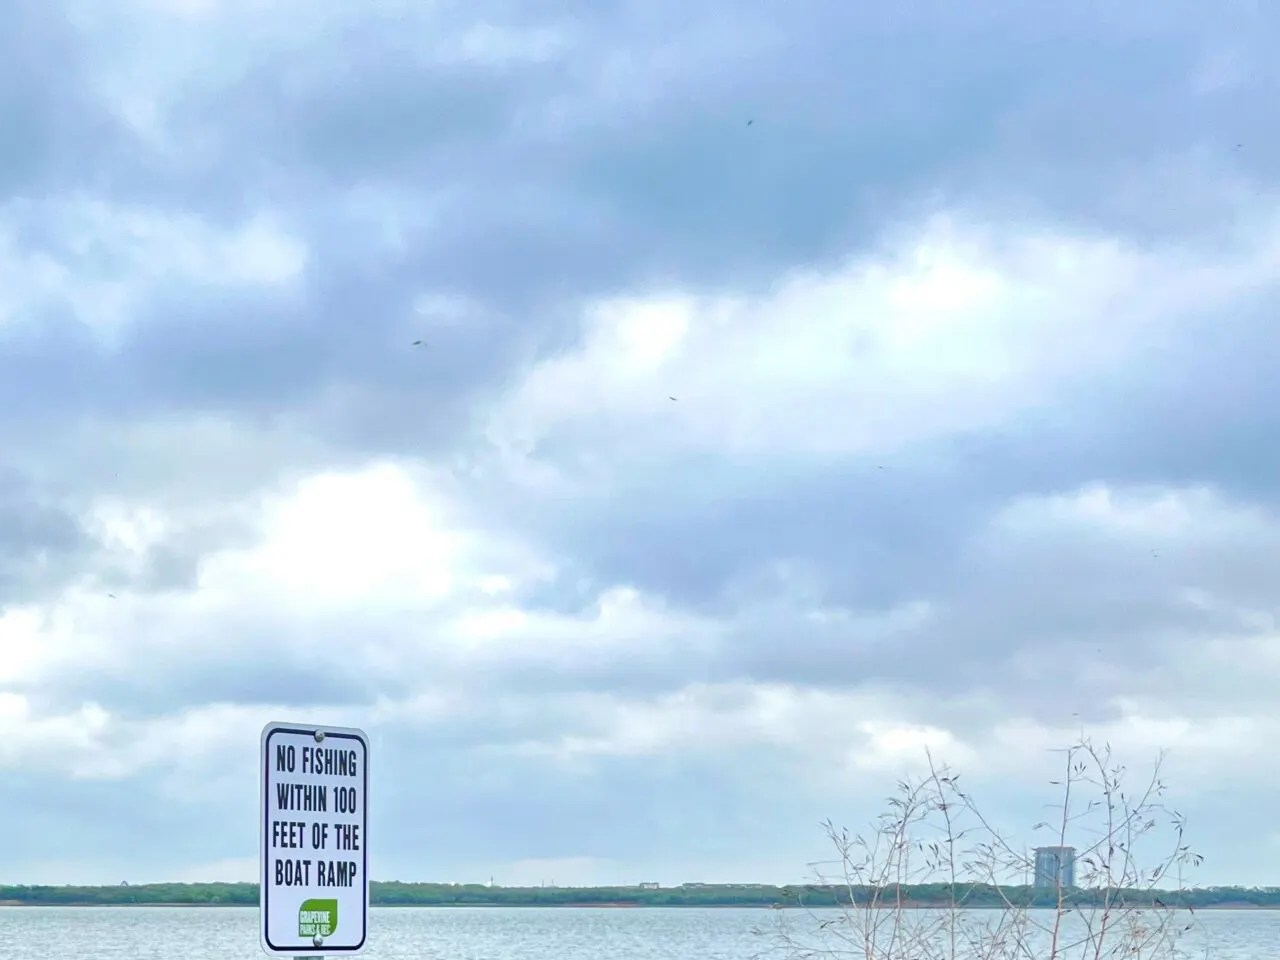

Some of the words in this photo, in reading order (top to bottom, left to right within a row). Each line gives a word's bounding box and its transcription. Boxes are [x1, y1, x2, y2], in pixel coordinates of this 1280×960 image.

[276, 745, 295, 773] NO
[302, 747, 357, 777] FISHING
[277, 783, 327, 812] WITHIN
[333, 787, 357, 814] 100
[273, 821, 306, 849] FEET
[312, 823, 328, 850] OF
[334, 824, 360, 851] THE
[275, 859, 312, 886] BOAT
[317, 860, 357, 887] RAMP
